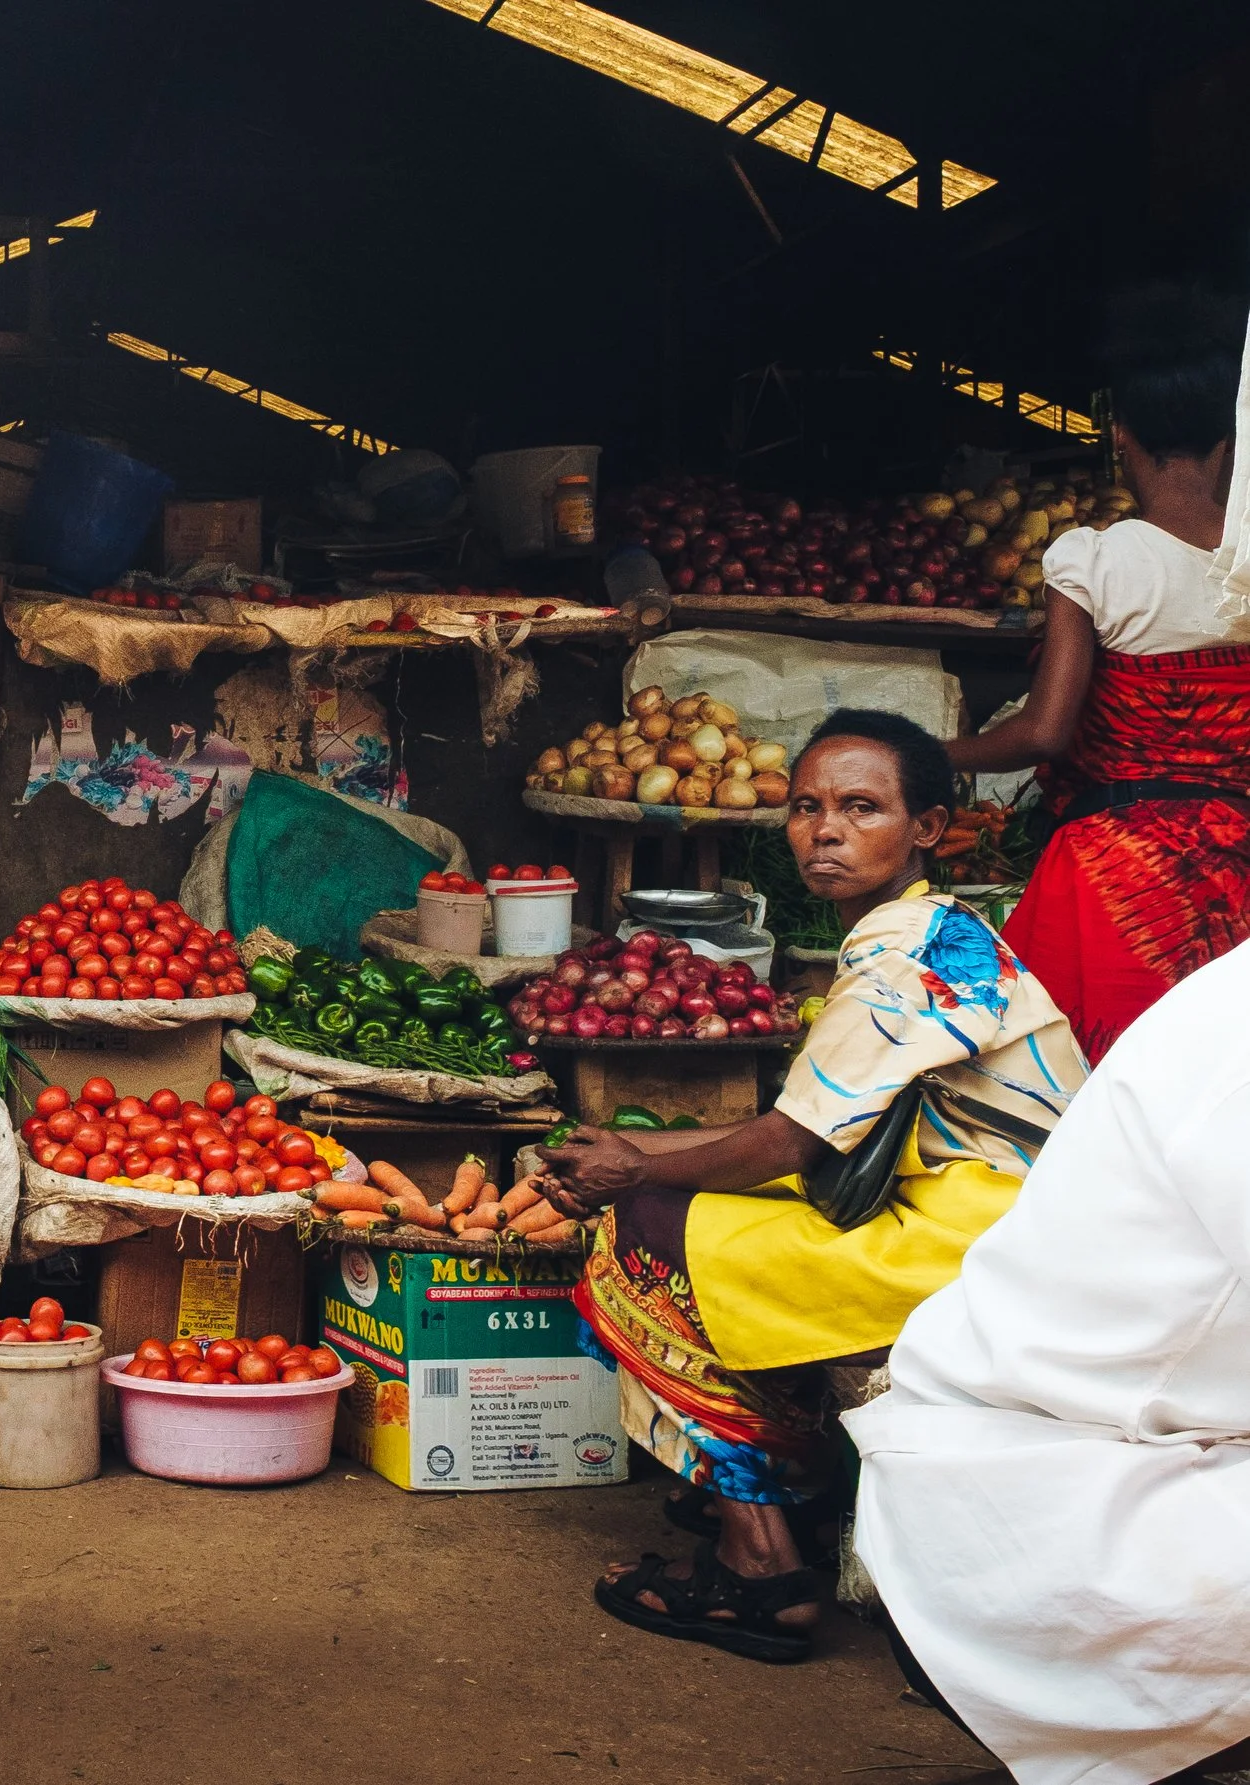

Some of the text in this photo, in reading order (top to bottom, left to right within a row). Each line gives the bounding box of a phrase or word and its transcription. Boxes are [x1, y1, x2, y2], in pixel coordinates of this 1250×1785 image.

[430, 1289, 472, 1299] SOYABEAN
[527, 1288, 559, 1297] REFINED
[325, 1296, 404, 1355] MUKWANO
[469, 1367, 508, 1375] Ingredients:
[536, 1374, 569, 1382] Soyabean
[470, 1401, 571, 1411] A.K. OILS & FATS (U) LTD.
[514, 1433, 541, 1441] Kampala
[572, 1432, 618, 1447] mukwano
